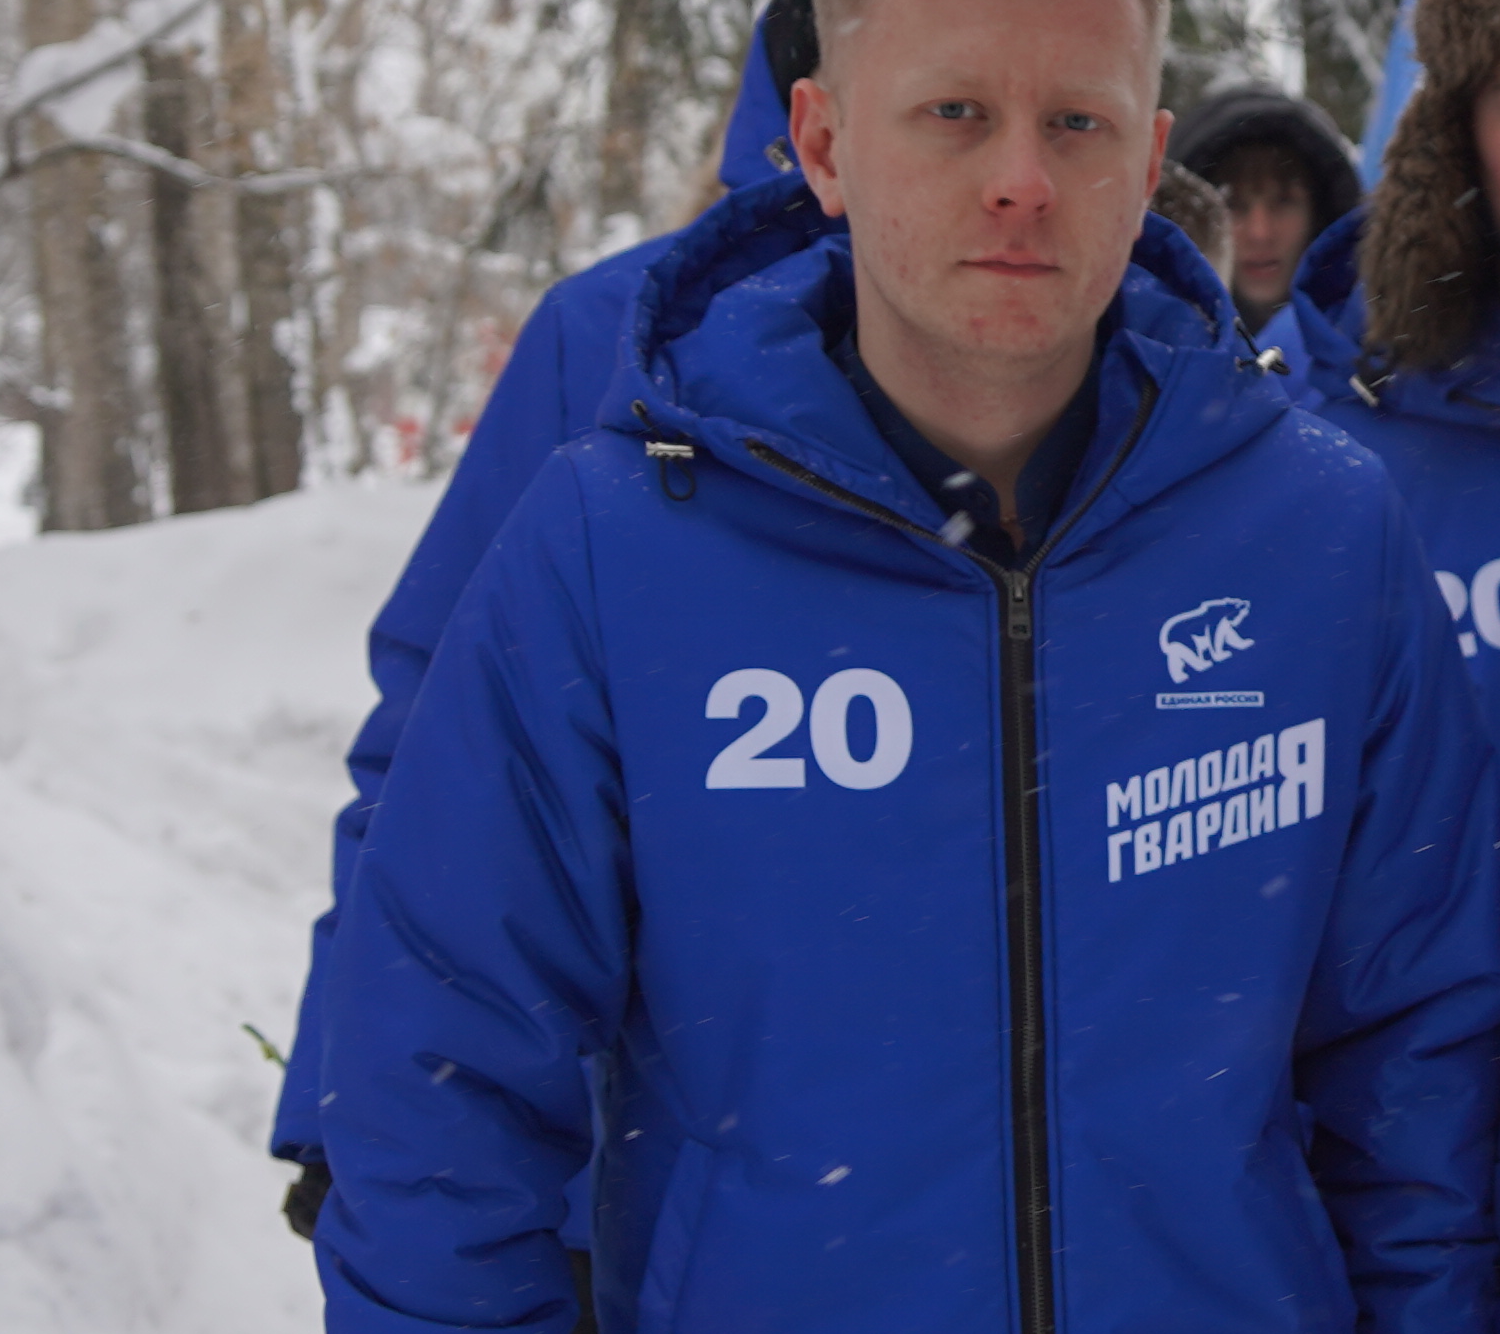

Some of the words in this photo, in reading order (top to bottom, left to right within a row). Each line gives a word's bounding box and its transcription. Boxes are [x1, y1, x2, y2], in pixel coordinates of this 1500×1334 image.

[705, 668, 913, 790] 20
[1161, 695, 1211, 706] ЕДИНАЯ
[1214, 694, 1260, 704] РОССИЯ
[1106, 717, 1325, 828] МОЛОДАЯ
[1107, 717, 1325, 883] ГВАРДИЯ
